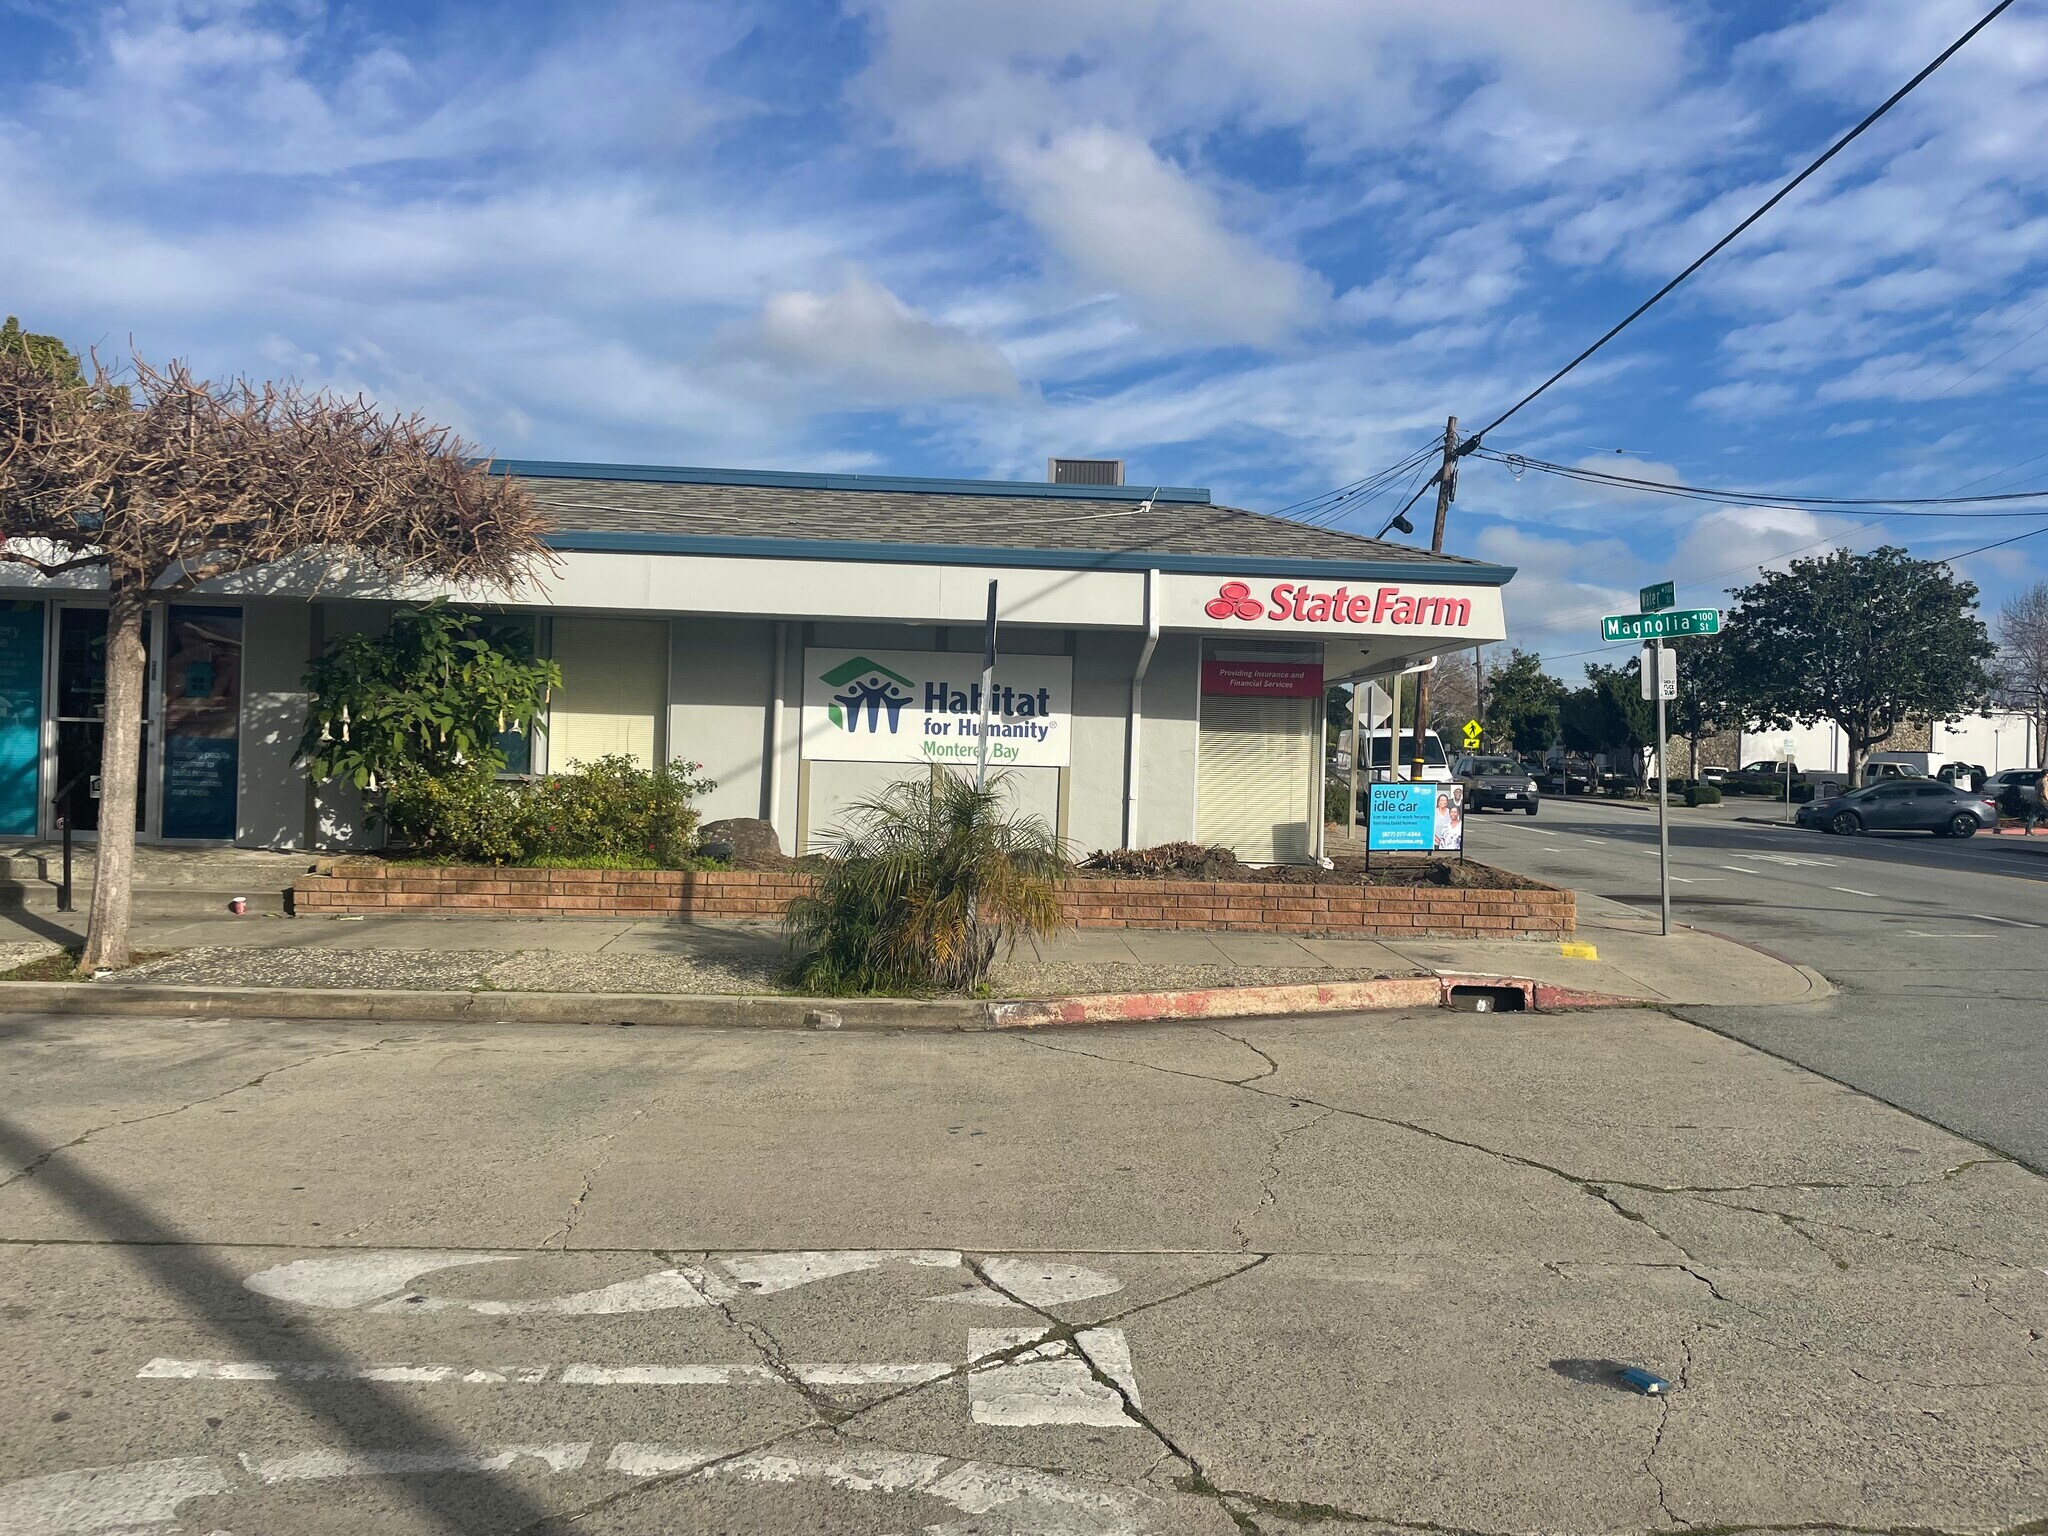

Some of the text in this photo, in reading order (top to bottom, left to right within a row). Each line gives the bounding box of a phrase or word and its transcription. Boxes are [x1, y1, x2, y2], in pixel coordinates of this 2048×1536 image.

[1699, 612, 1713, 621] 100
[1608, 616, 1709, 638] Magnolia St
[1219, 669, 1253, 679] Providing
[1254, 670, 1288, 679] Insurance
[1229, 679, 1293, 688] Financial Services
[924, 682, 1050, 717] Habitat
[924, 717, 1048, 742] for Humanity
[924, 741, 1020, 761] Montere Bay
[1374, 790, 1408, 801] every
[1374, 800, 1418, 812] idle car
